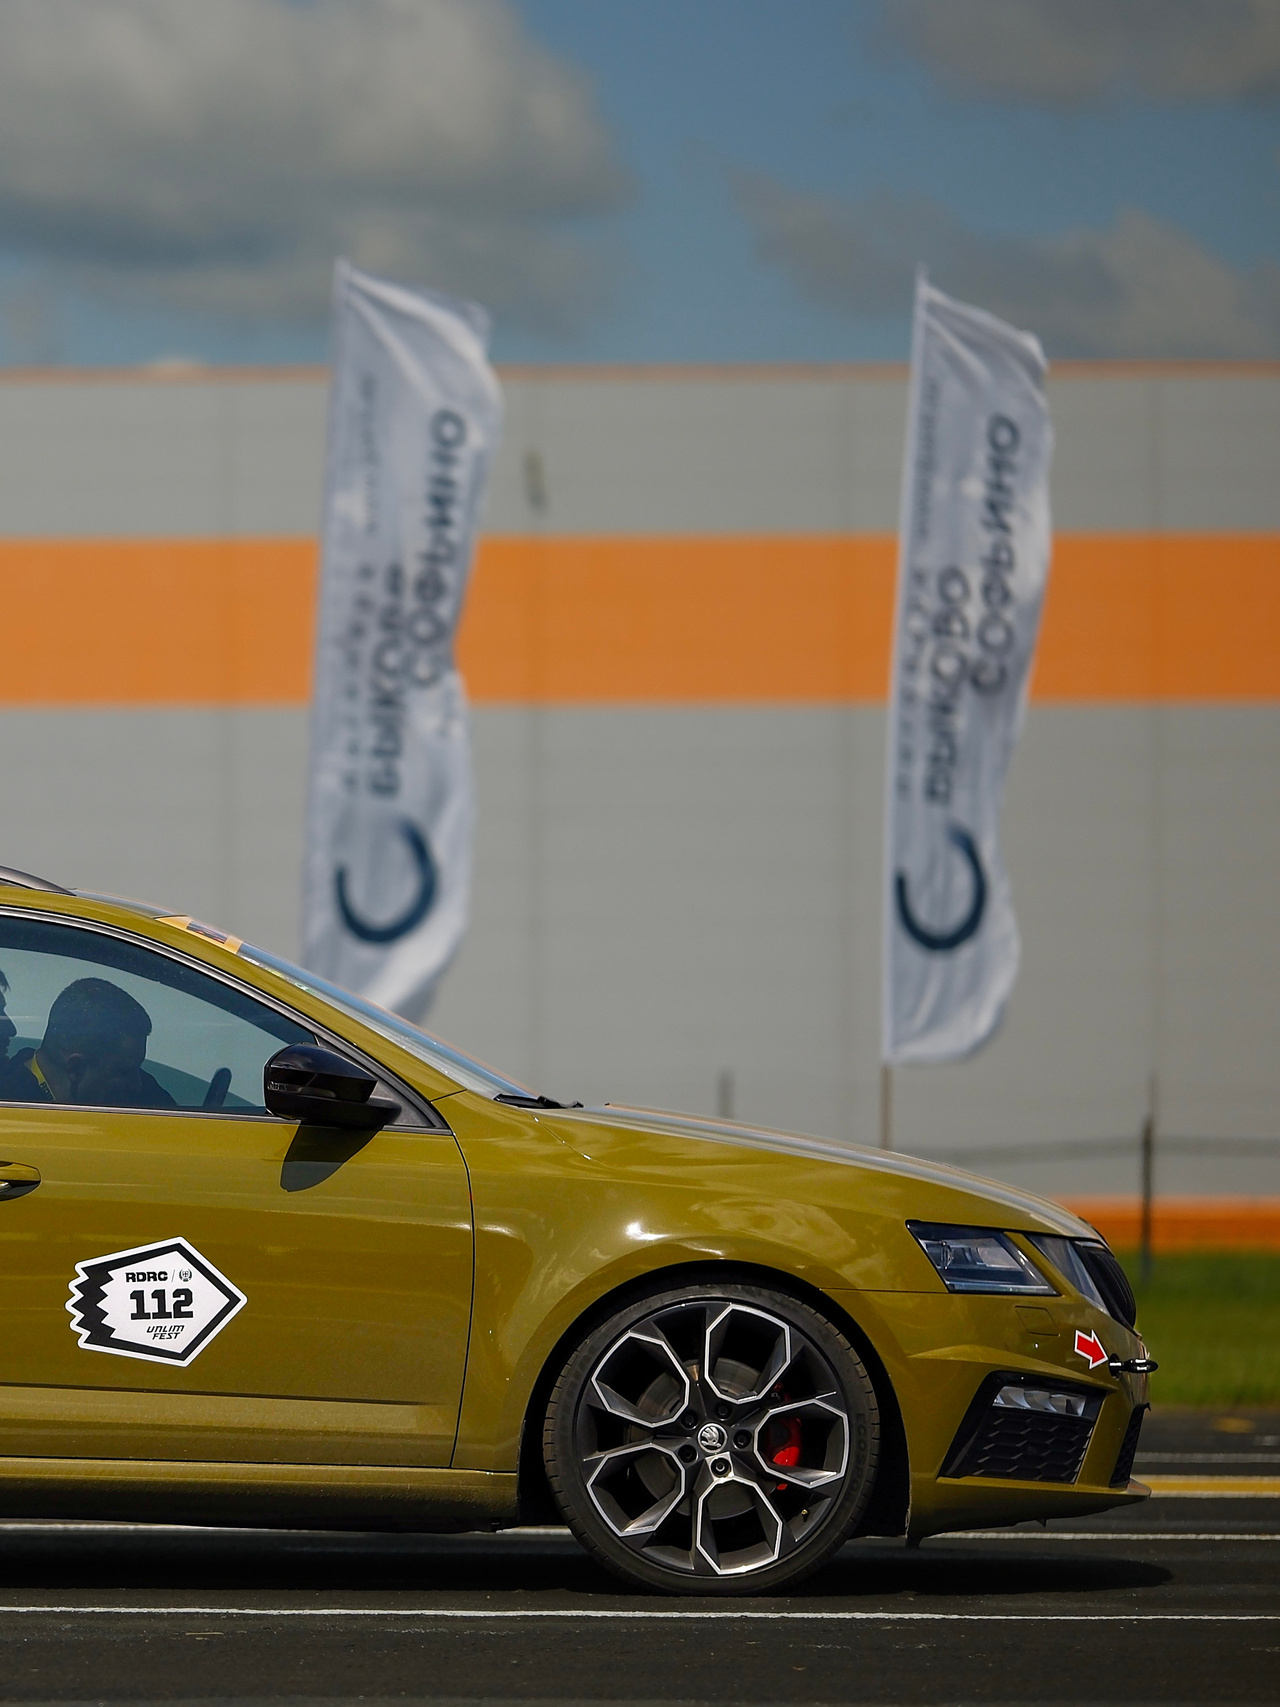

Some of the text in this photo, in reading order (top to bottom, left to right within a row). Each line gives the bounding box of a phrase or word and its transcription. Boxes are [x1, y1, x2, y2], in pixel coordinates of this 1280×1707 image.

[125, 1270, 169, 1283] RDRC
[129, 1287, 194, 1321] 112
[146, 1324, 185, 1334] UNLIM
[152, 1332, 181, 1340] FEST
